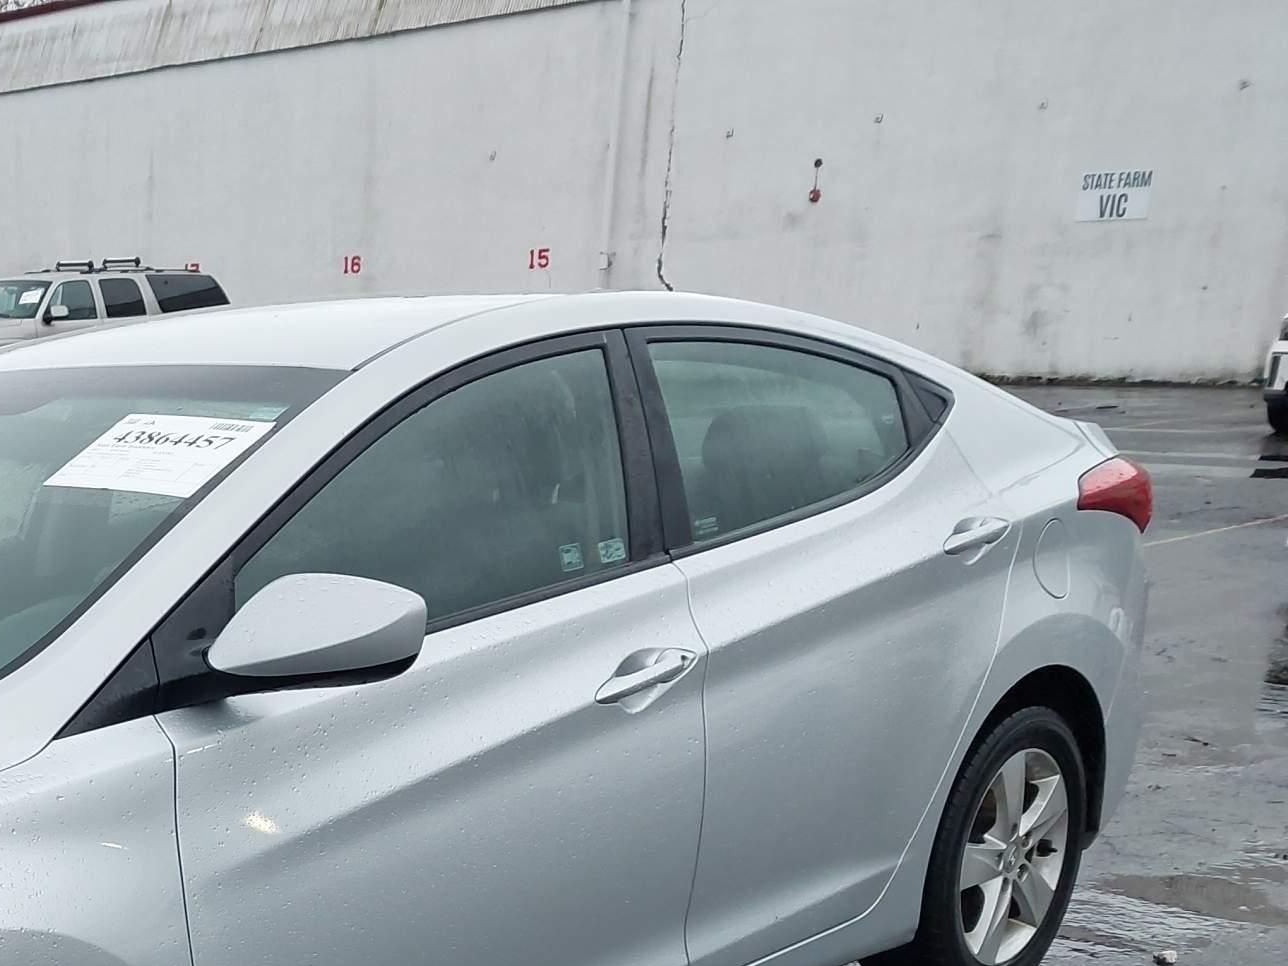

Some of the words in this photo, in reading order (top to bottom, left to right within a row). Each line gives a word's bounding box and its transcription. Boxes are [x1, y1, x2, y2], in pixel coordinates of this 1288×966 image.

[1082, 172, 1115, 191] STATE
[1117, 170, 1153, 188] FARM
[1099, 193, 1128, 218] VIC
[343, 256, 362, 274] 16
[528, 248, 551, 270] 15
[114, 430, 236, 449] 43864457
